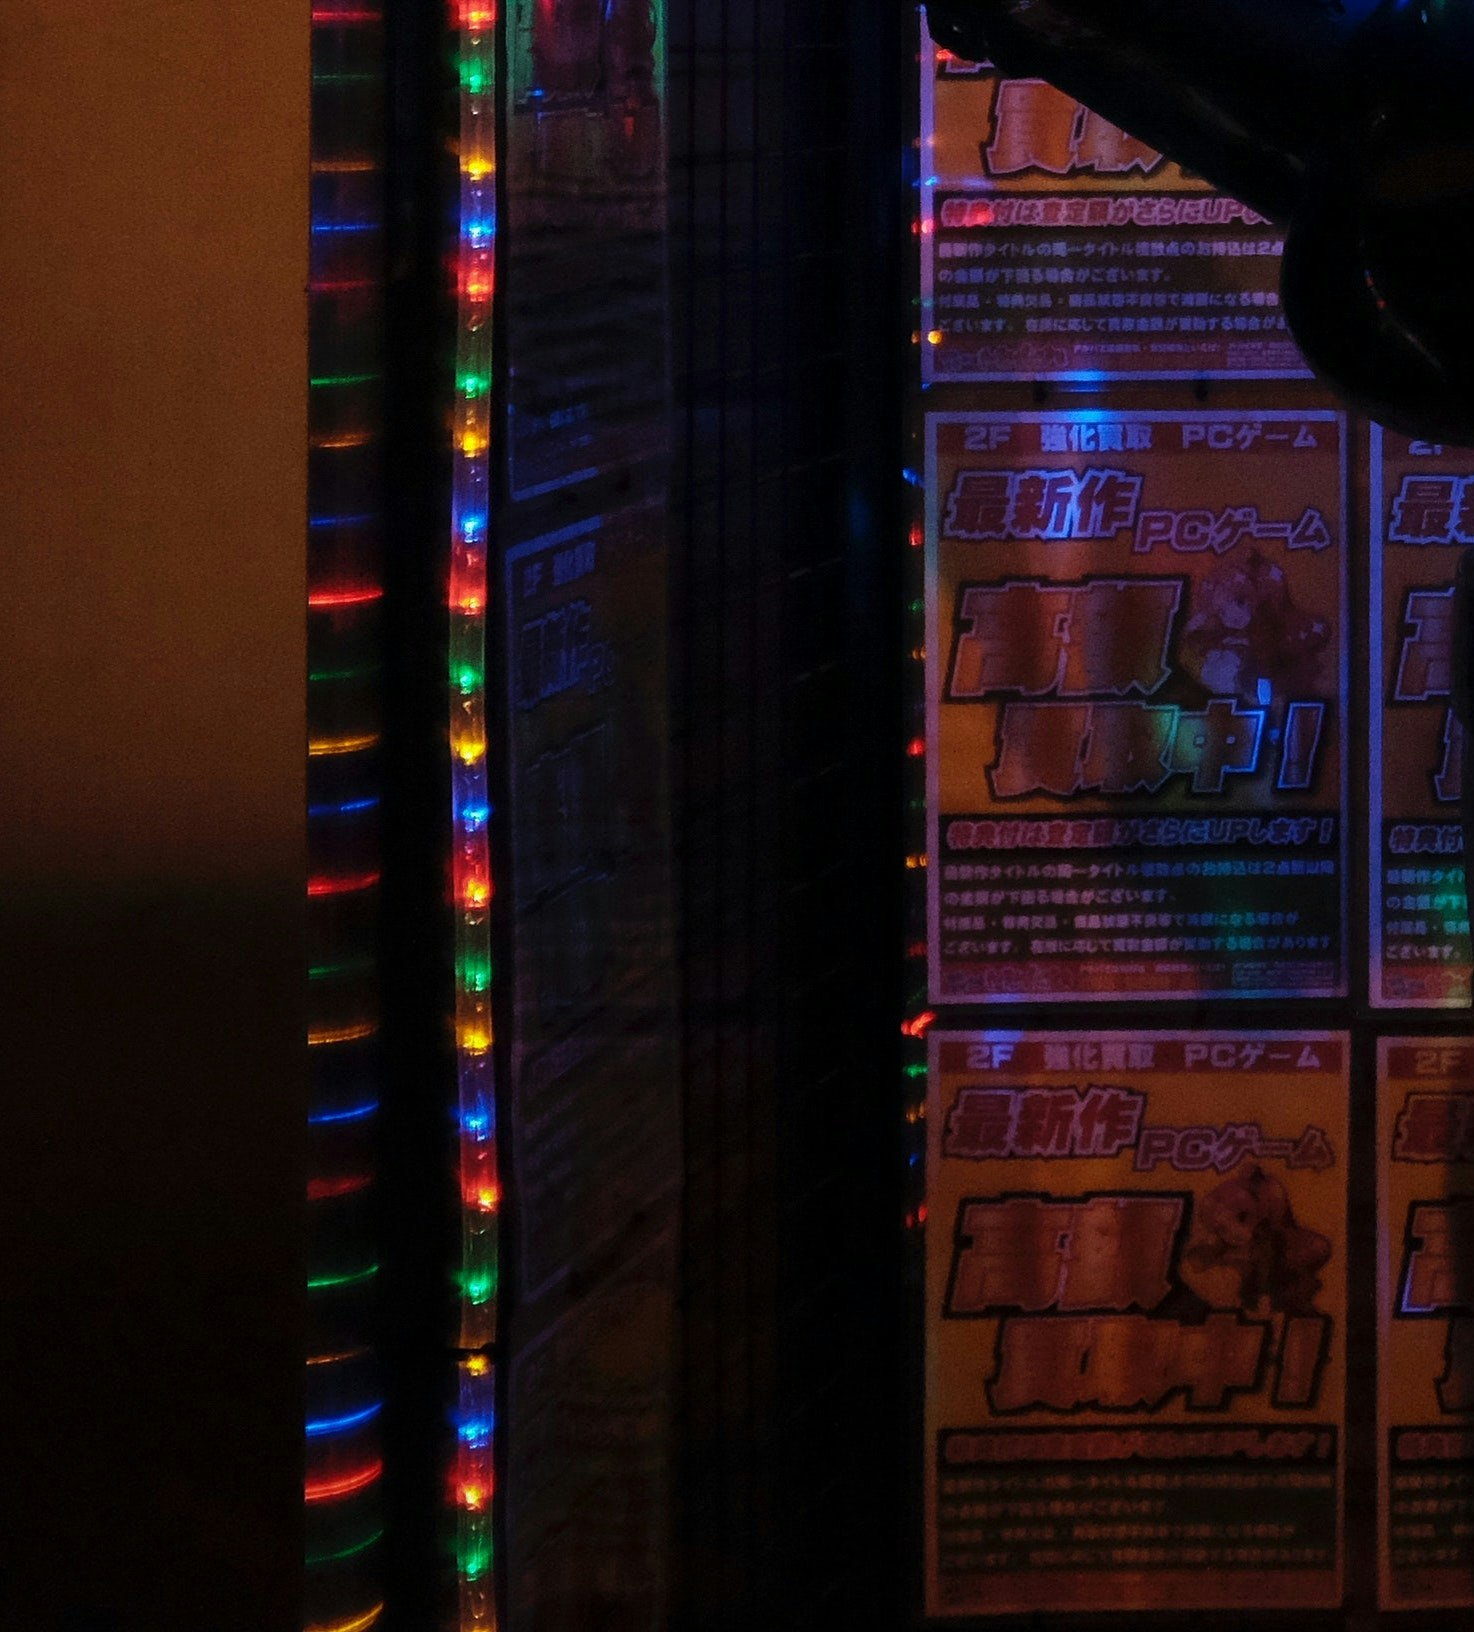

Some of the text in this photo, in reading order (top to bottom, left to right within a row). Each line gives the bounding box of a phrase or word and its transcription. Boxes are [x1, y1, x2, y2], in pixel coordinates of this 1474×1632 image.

[964, 422, 1319, 452] 2F 強化買取 PCゲーム
[945, 468, 1333, 553] 最新作 PCゲーム
[966, 1042, 1322, 1072] 2F 強化買取 PCゲーム
[946, 1087, 1334, 1173] 最新作 PCゲーム
